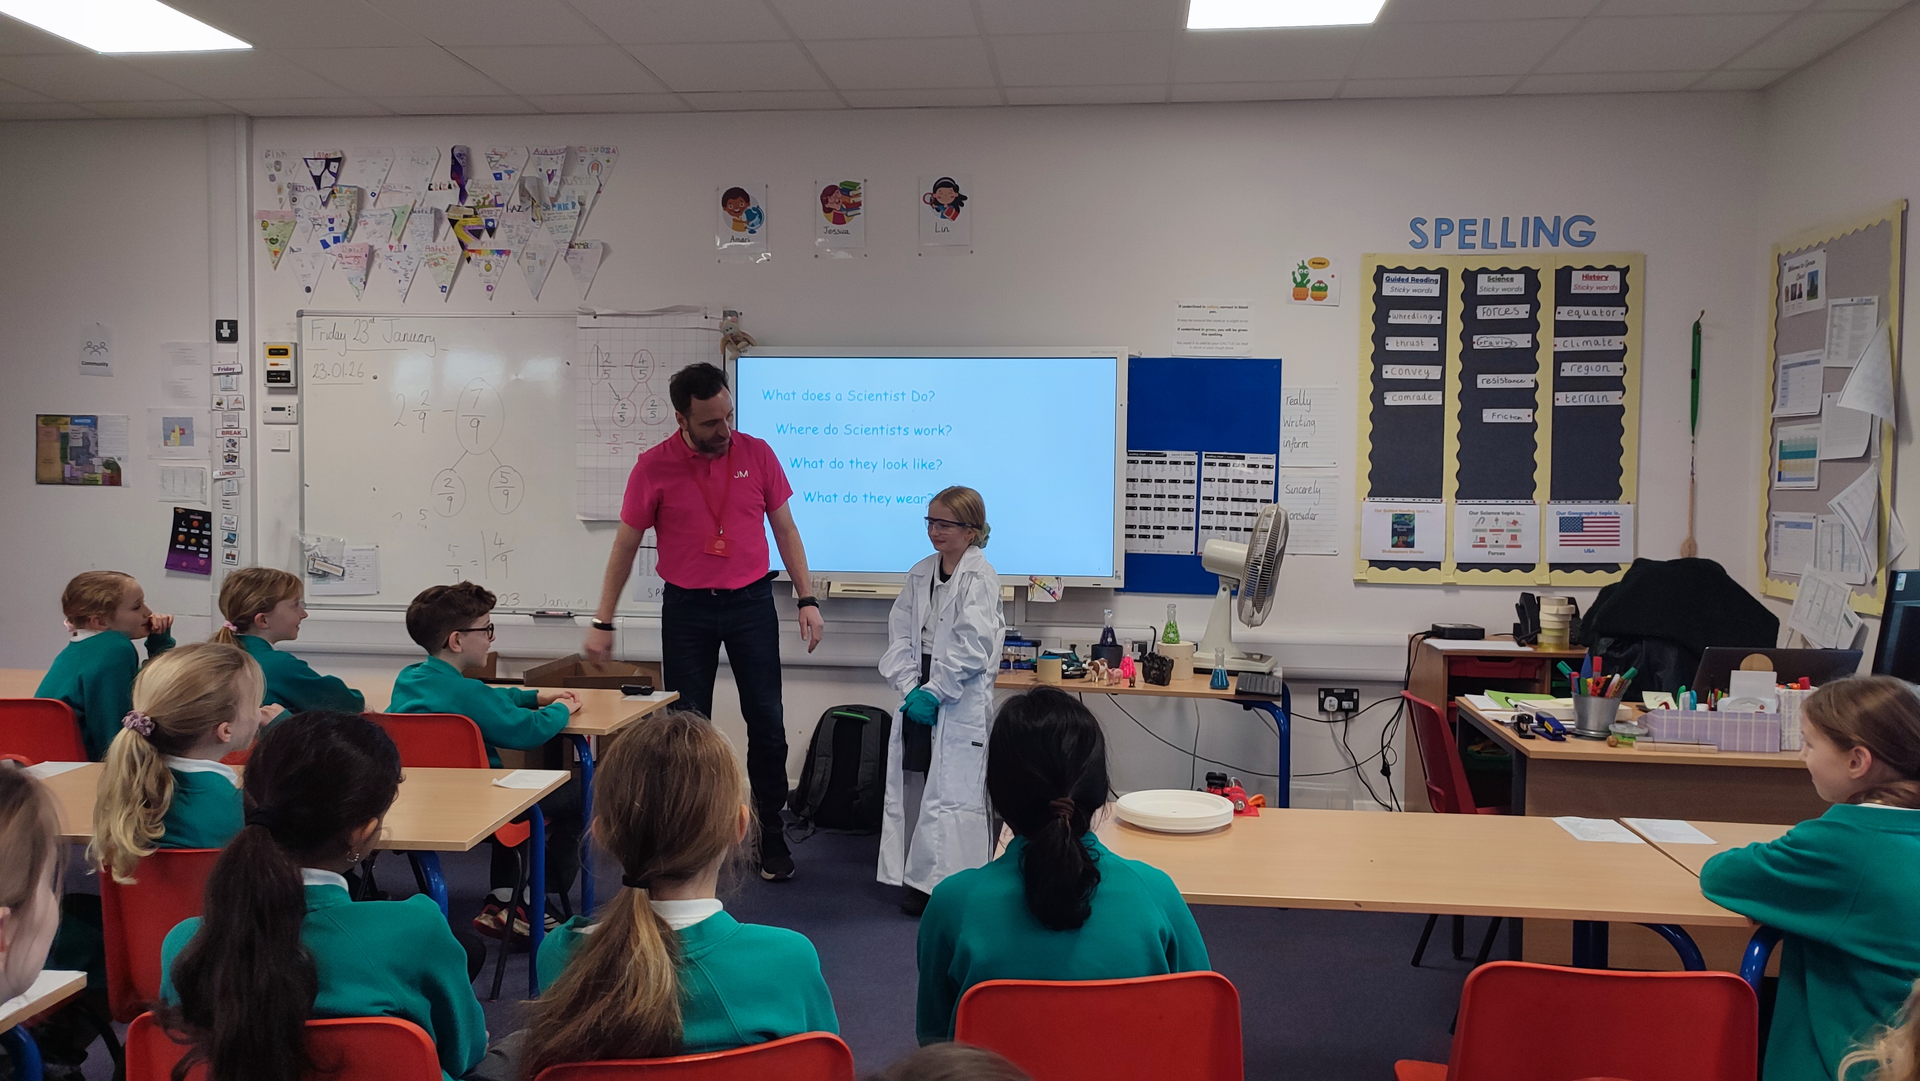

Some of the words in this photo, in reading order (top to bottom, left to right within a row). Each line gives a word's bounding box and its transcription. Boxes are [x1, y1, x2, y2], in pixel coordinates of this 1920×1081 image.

[823, 226, 851, 236] Jessica
[935, 222, 950, 234] Lin
[1409, 215, 1597, 249] SPELLING
[1385, 276, 1410, 284] Guided
[1411, 277, 1439, 285] Reading
[1582, 273, 1610, 282] History
[1390, 286, 1410, 294] Sticky
[1479, 285, 1500, 293] Sticky
[1573, 284, 1593, 292] Sticky
[1566, 307, 1617, 319] equator
[311, 318, 348, 357] Friday
[381, 317, 437, 359] January
[1396, 339, 1425, 348] thrust
[1563, 338, 1613, 348] climate
[81, 360, 109, 368] Community
[1570, 364, 1611, 375] region
[312, 361, 365, 380] 23.01.26
[1482, 376, 1527, 385] resistance
[762, 389, 797, 402] What
[802, 389, 831, 402] does
[836, 393, 843, 402] a
[848, 389, 907, 403] Scientist
[911, 389, 937, 403] Do?
[1286, 389, 1312, 414] really
[1391, 393, 1434, 402] comrade
[1565, 393, 1611, 404] terrain
[776, 423, 820, 436] Where
[824, 424, 839, 436] do
[844, 423, 910, 437] Scientists
[914, 424, 953, 438] work?
[1283, 437, 1309, 453] inform
[789, 457, 825, 470] What
[830, 458, 845, 470] do
[849, 458, 878, 473] they
[883, 458, 909, 471] look
[913, 458, 943, 472] like?
[733, 470, 749, 479] JM
[1285, 480, 1321, 506] Sincerely
[803, 491, 838, 503] What
[843, 491, 858, 504] do
[862, 492, 892, 507] they
[1289, 507, 1319, 521] onsider
[1568, 510, 1597, 518] Geography
[648, 587, 664, 599] SP
[499, 592, 521, 607] 23
